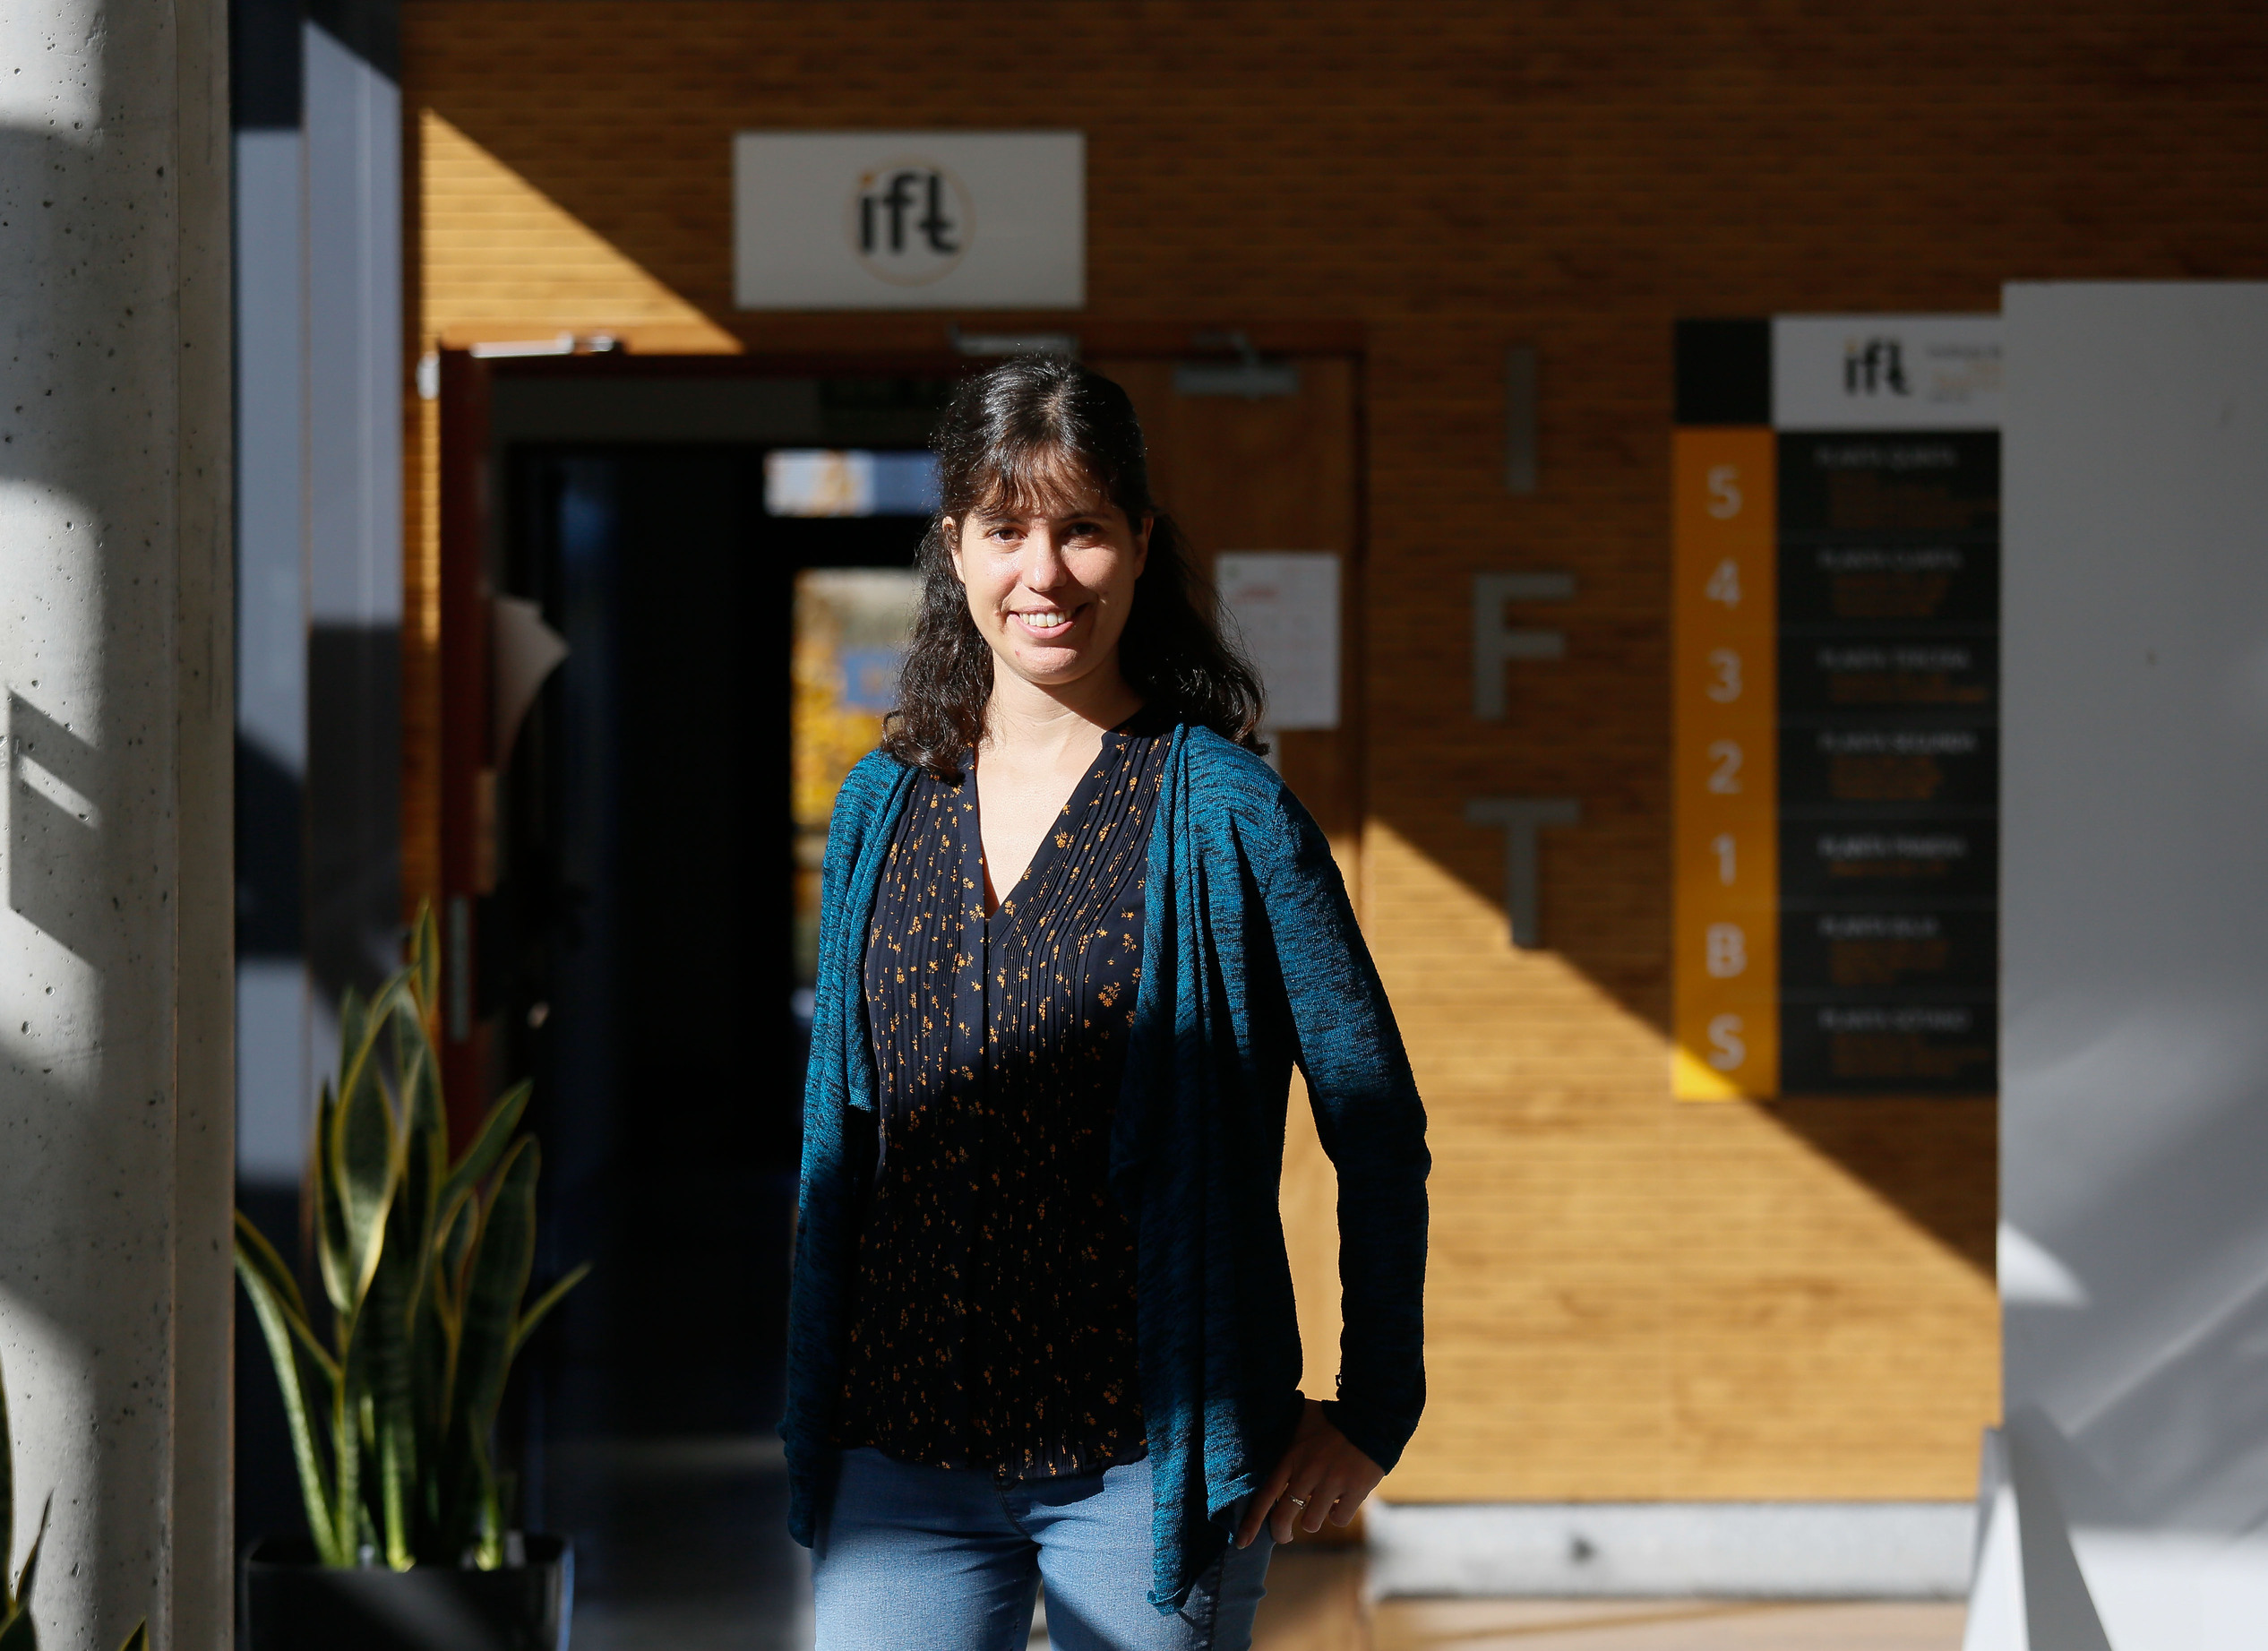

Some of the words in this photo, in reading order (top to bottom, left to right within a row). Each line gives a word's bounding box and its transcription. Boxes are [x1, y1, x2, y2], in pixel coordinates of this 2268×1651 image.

[1705, 465, 1743, 520] 5
[1705, 557, 1742, 610] 4
[1705, 648, 1743, 703] 3
[1706, 739, 1744, 795] 2
[1711, 832, 1738, 887] 1
[1705, 923, 1747, 977] B
[1707, 1013, 1747, 1071] S
